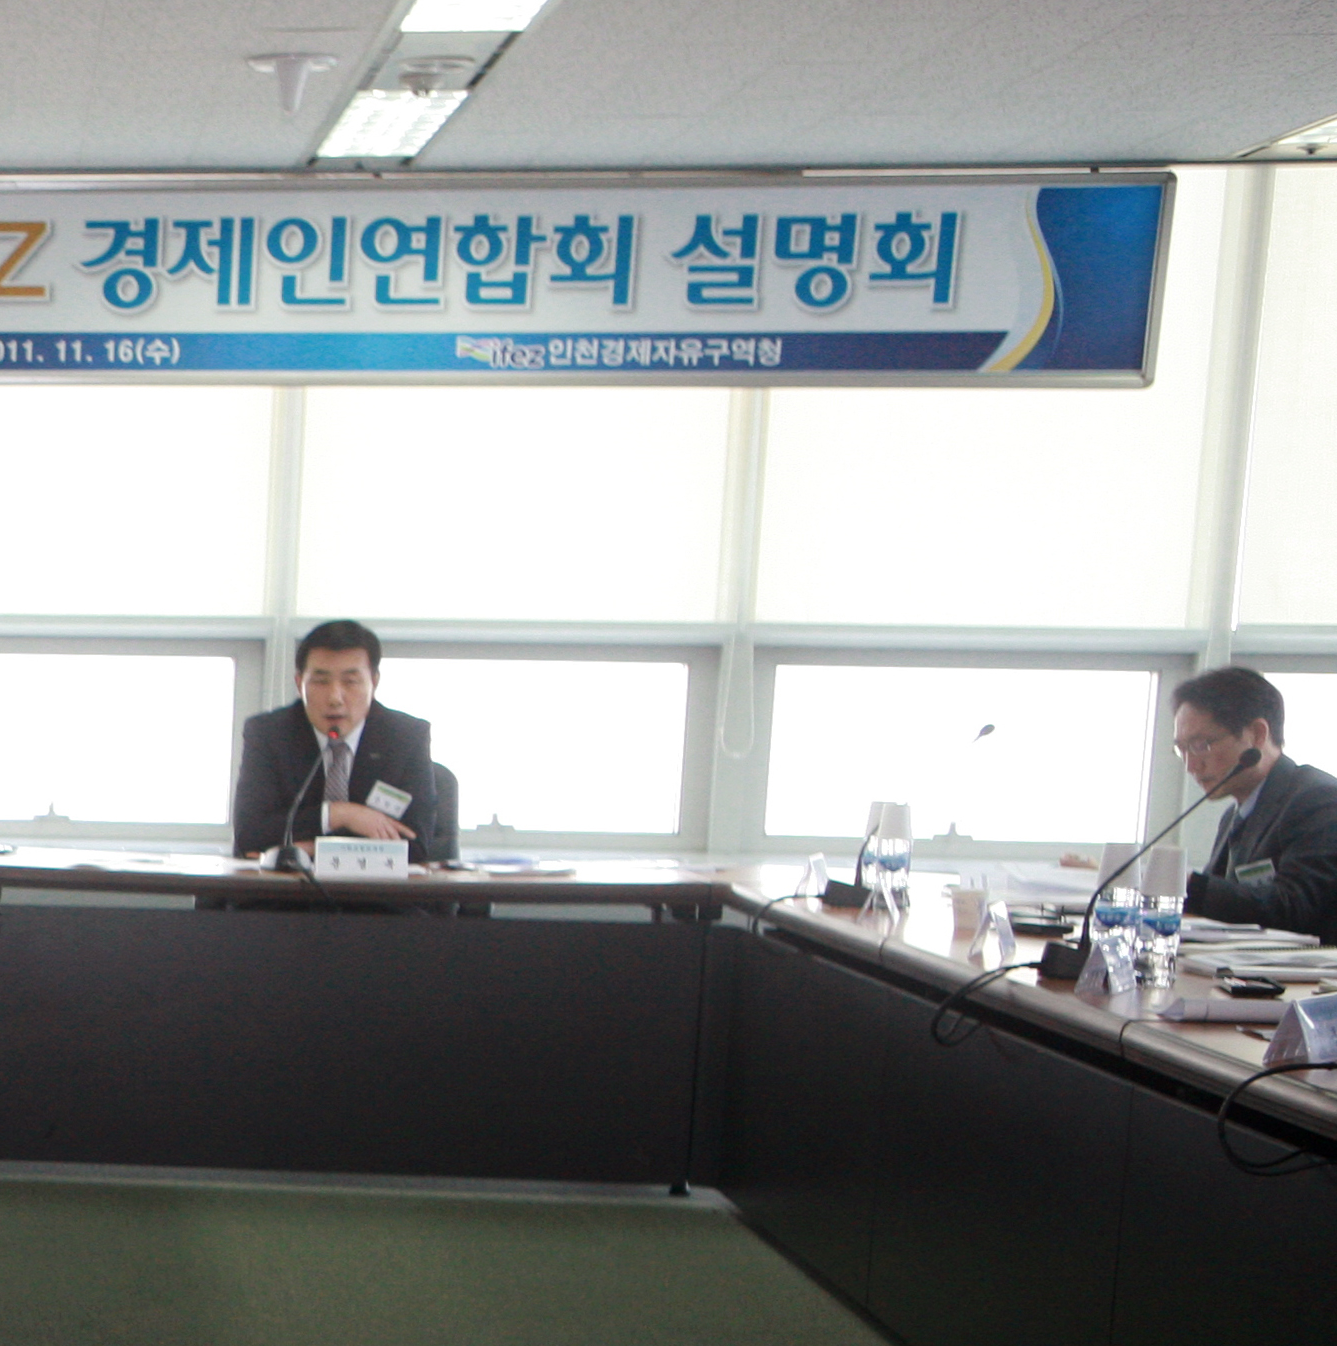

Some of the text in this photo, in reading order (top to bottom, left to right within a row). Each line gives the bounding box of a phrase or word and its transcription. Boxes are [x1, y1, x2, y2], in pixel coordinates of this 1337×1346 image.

[81, 213, 637, 310] 경제인연합회
[671, 209, 961, 309] 설명회
[55, 338, 93, 363] 11.
[104, 337, 181, 366] 16(수)
[548, 337, 782, 367] 인천경제자유구역청
